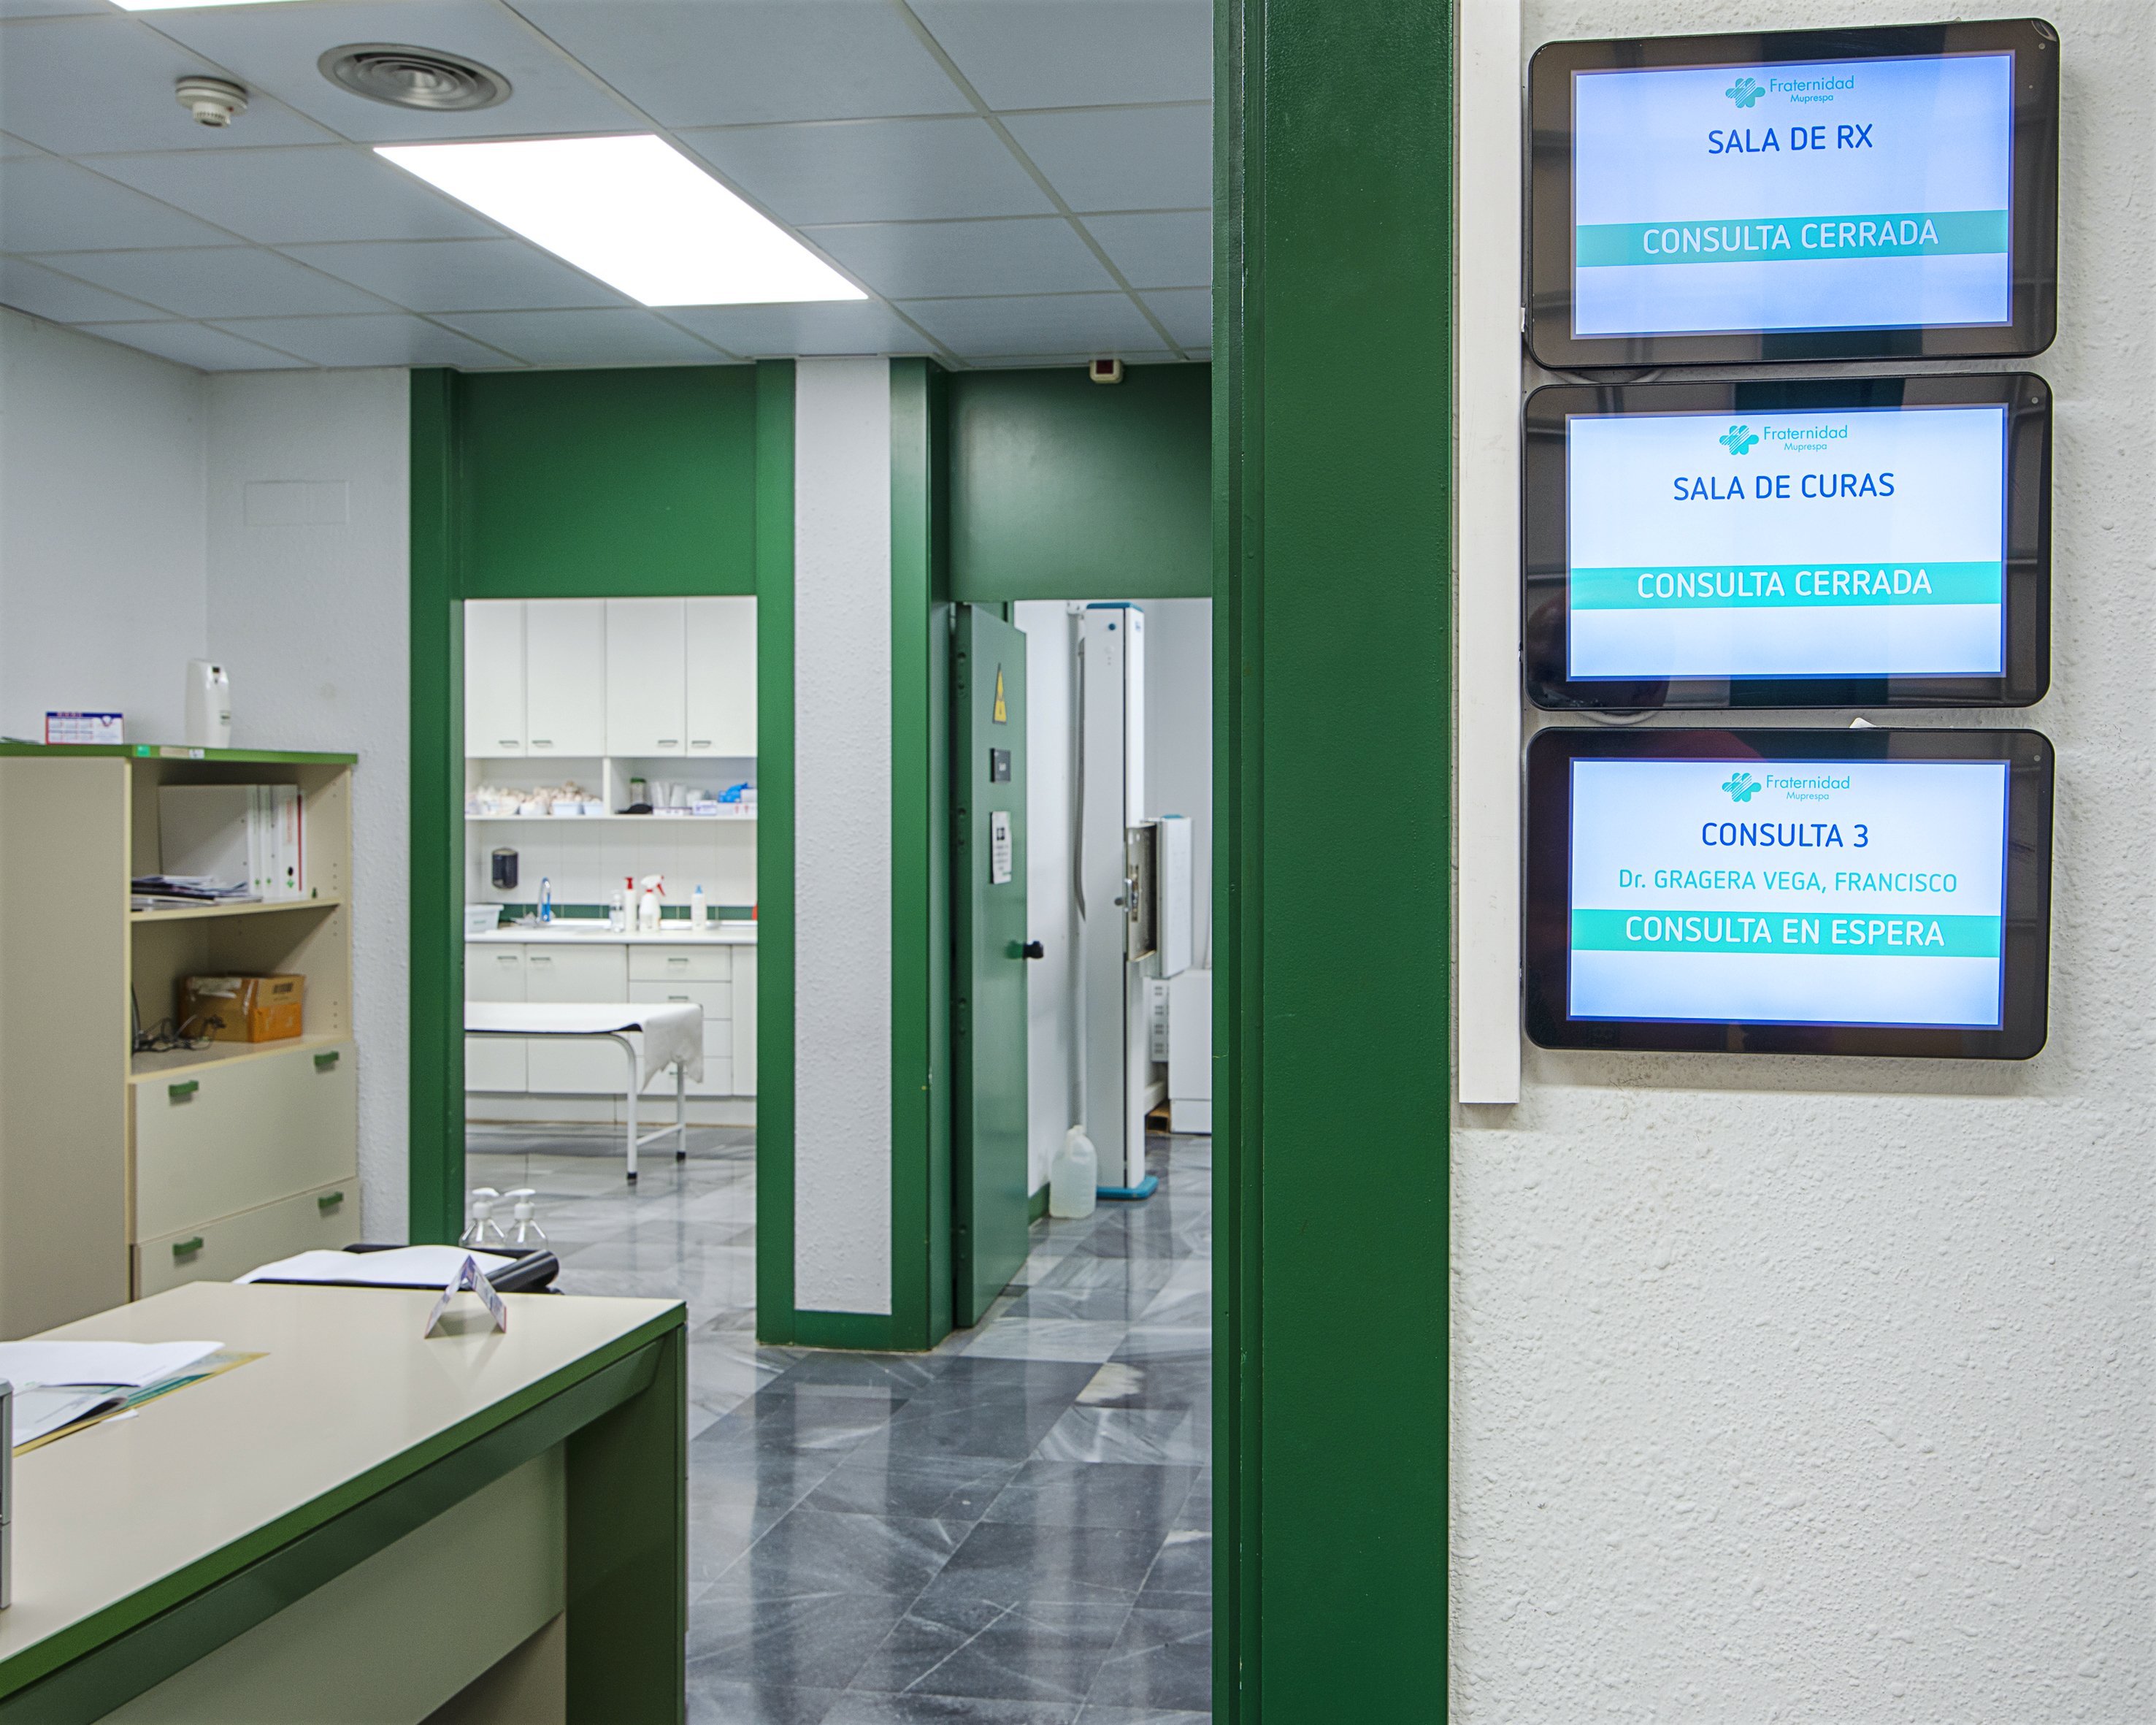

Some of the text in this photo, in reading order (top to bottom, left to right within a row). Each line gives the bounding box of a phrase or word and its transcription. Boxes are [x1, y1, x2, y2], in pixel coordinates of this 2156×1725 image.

[1770, 74, 1854, 92] Fraternidad
[1790, 94, 1834, 104] Muprespa
[1708, 123, 1873, 154] SALA DE RX
[1643, 219, 1939, 254] CONSULTA CERRADA
[1764, 424, 1848, 440] Fraternidad
[1784, 443, 1827, 453] Muprespa
[1673, 472, 1895, 501] SALA DE CURAS
[1637, 569, 1933, 599] CONSULTA CERRADA
[1766, 774, 1850, 789] Fraternidad
[1786, 791, 1830, 802] Muprespa
[1702, 822, 1868, 848] CONSULTA 3
[1619, 869, 1957, 894] Dr. GRAGERA VEGA, FRANCISCO
[1625, 916, 1945, 947] CONSULTA EN ESPERA
